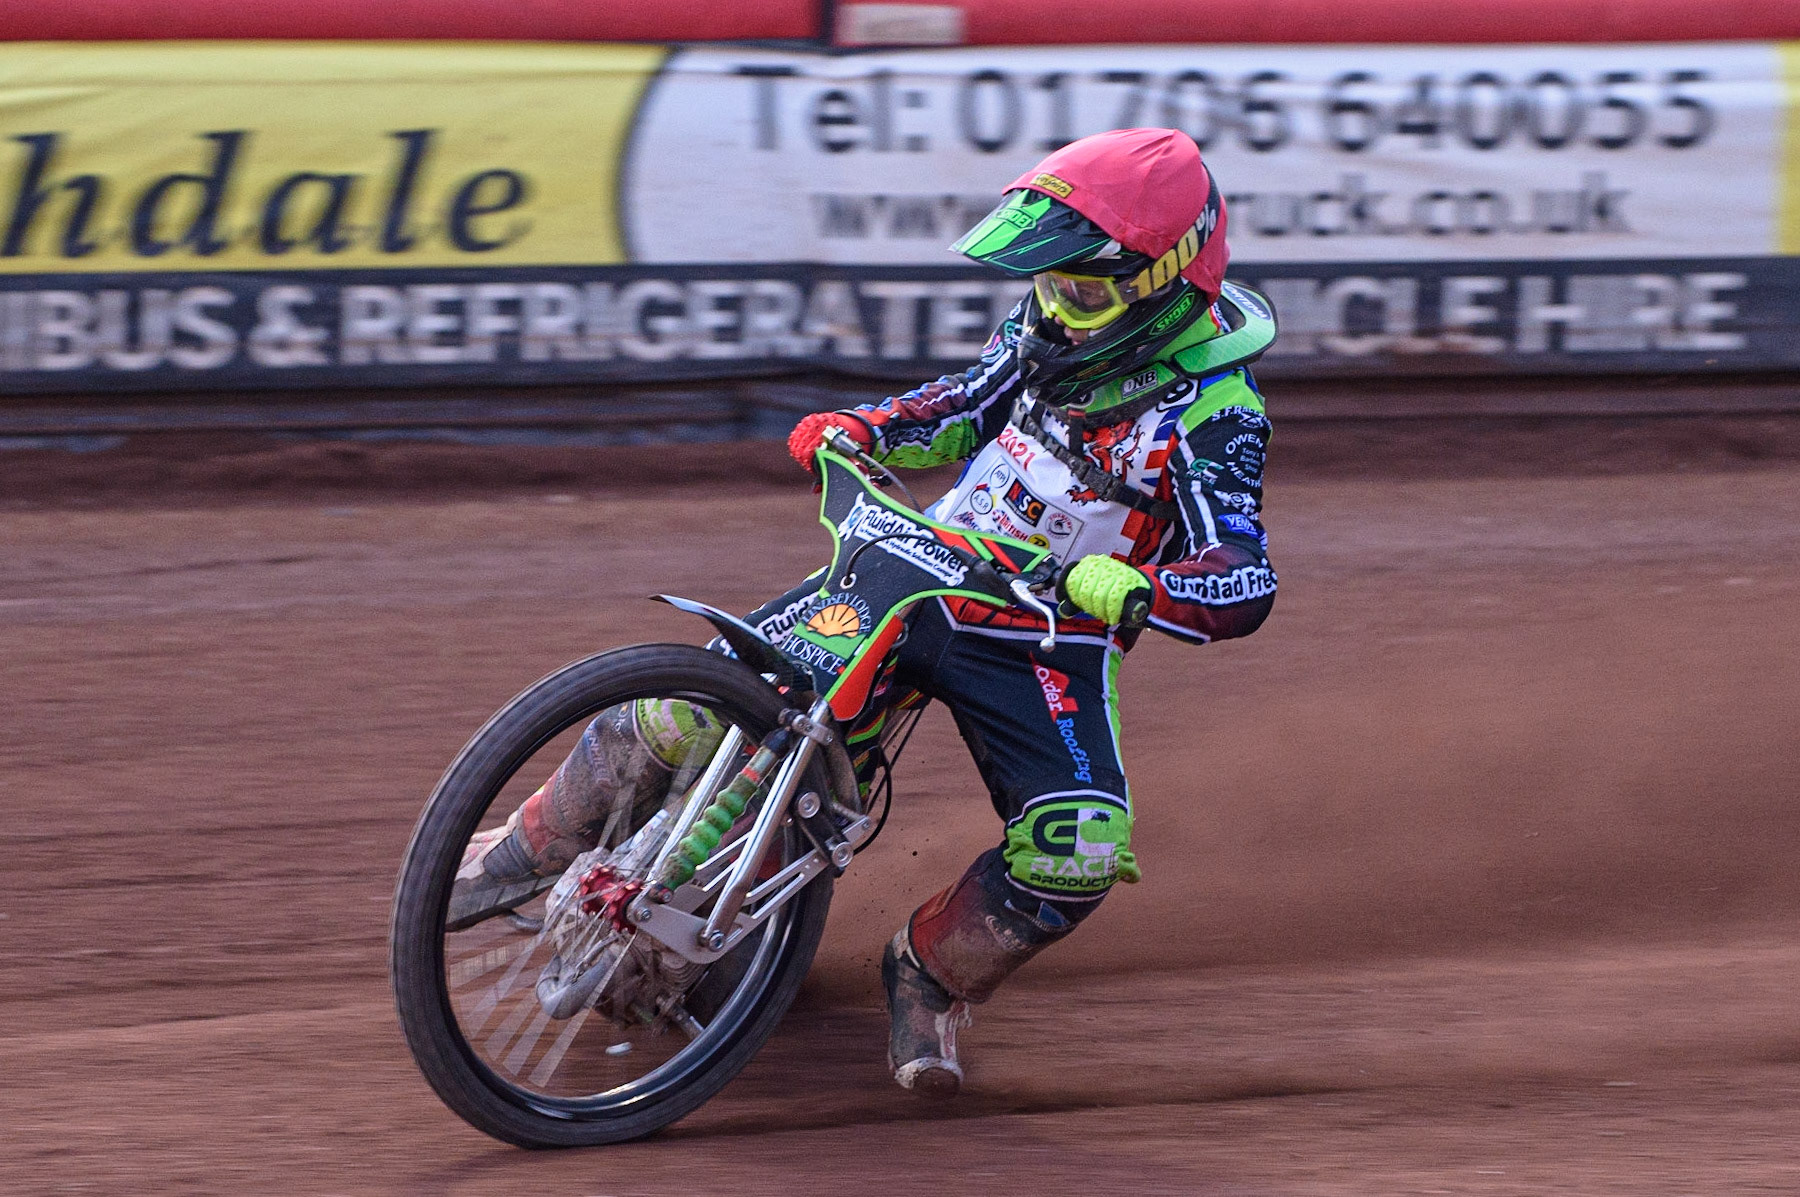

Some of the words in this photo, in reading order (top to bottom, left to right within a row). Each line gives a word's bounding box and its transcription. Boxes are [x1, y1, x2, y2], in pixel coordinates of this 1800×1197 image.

[733, 64, 930, 153] Tel:
[1323, 69, 1716, 151] 640055
[0, 128, 536, 259] hdale
[1129, 203, 1217, 300] 100%
[247, 284, 330, 369] &
[1514, 271, 1748, 355] HIRE
[1155, 296, 1194, 333] SHOEI
[996, 427, 1036, 472] 2021
[1225, 433, 1264, 455] OWEN
[780, 634, 845, 676] HOSPICE
[1056, 717, 1093, 784] Roofing
[1029, 872, 1120, 888] PRODUCTS
